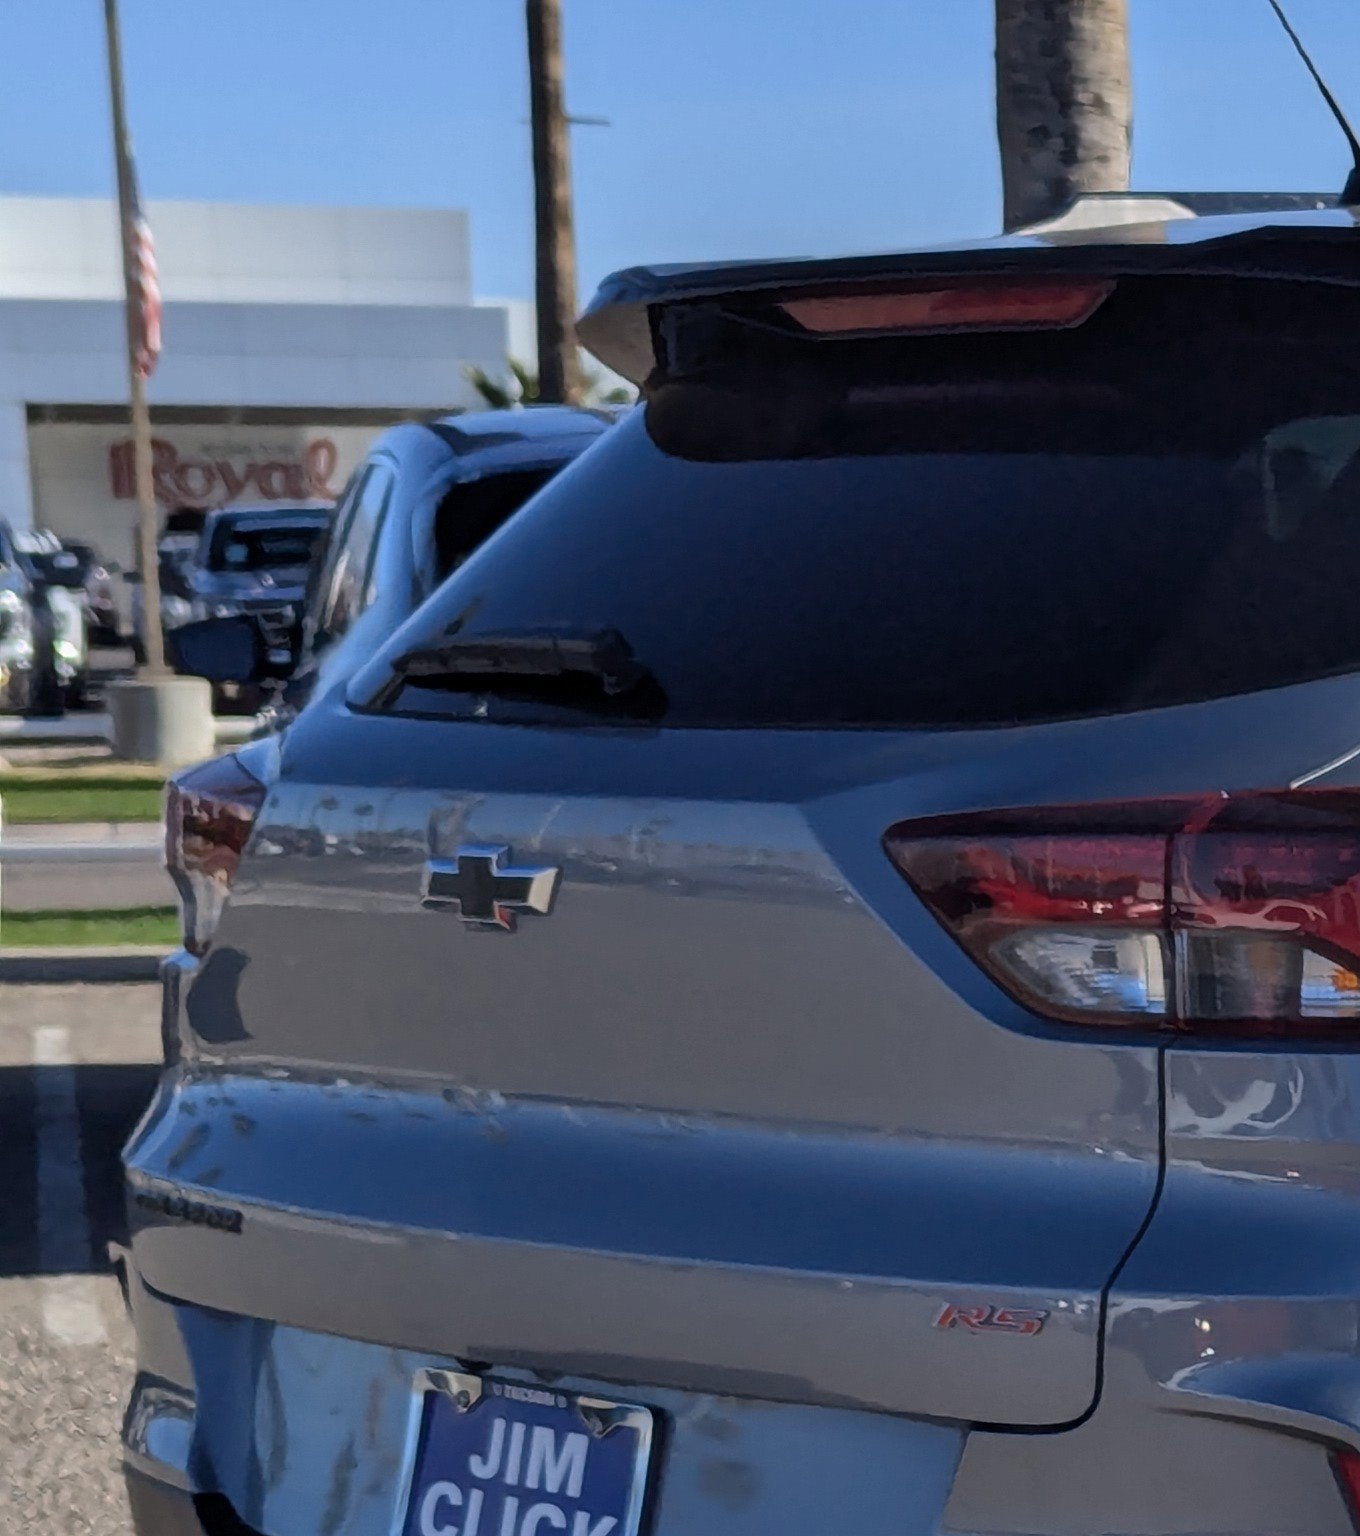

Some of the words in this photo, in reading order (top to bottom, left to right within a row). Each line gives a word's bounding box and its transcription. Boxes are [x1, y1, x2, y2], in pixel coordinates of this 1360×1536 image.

[110, 435, 338, 509] Royal
[932, 1301, 1046, 1336] RS
[469, 1417, 590, 1498] JIM
